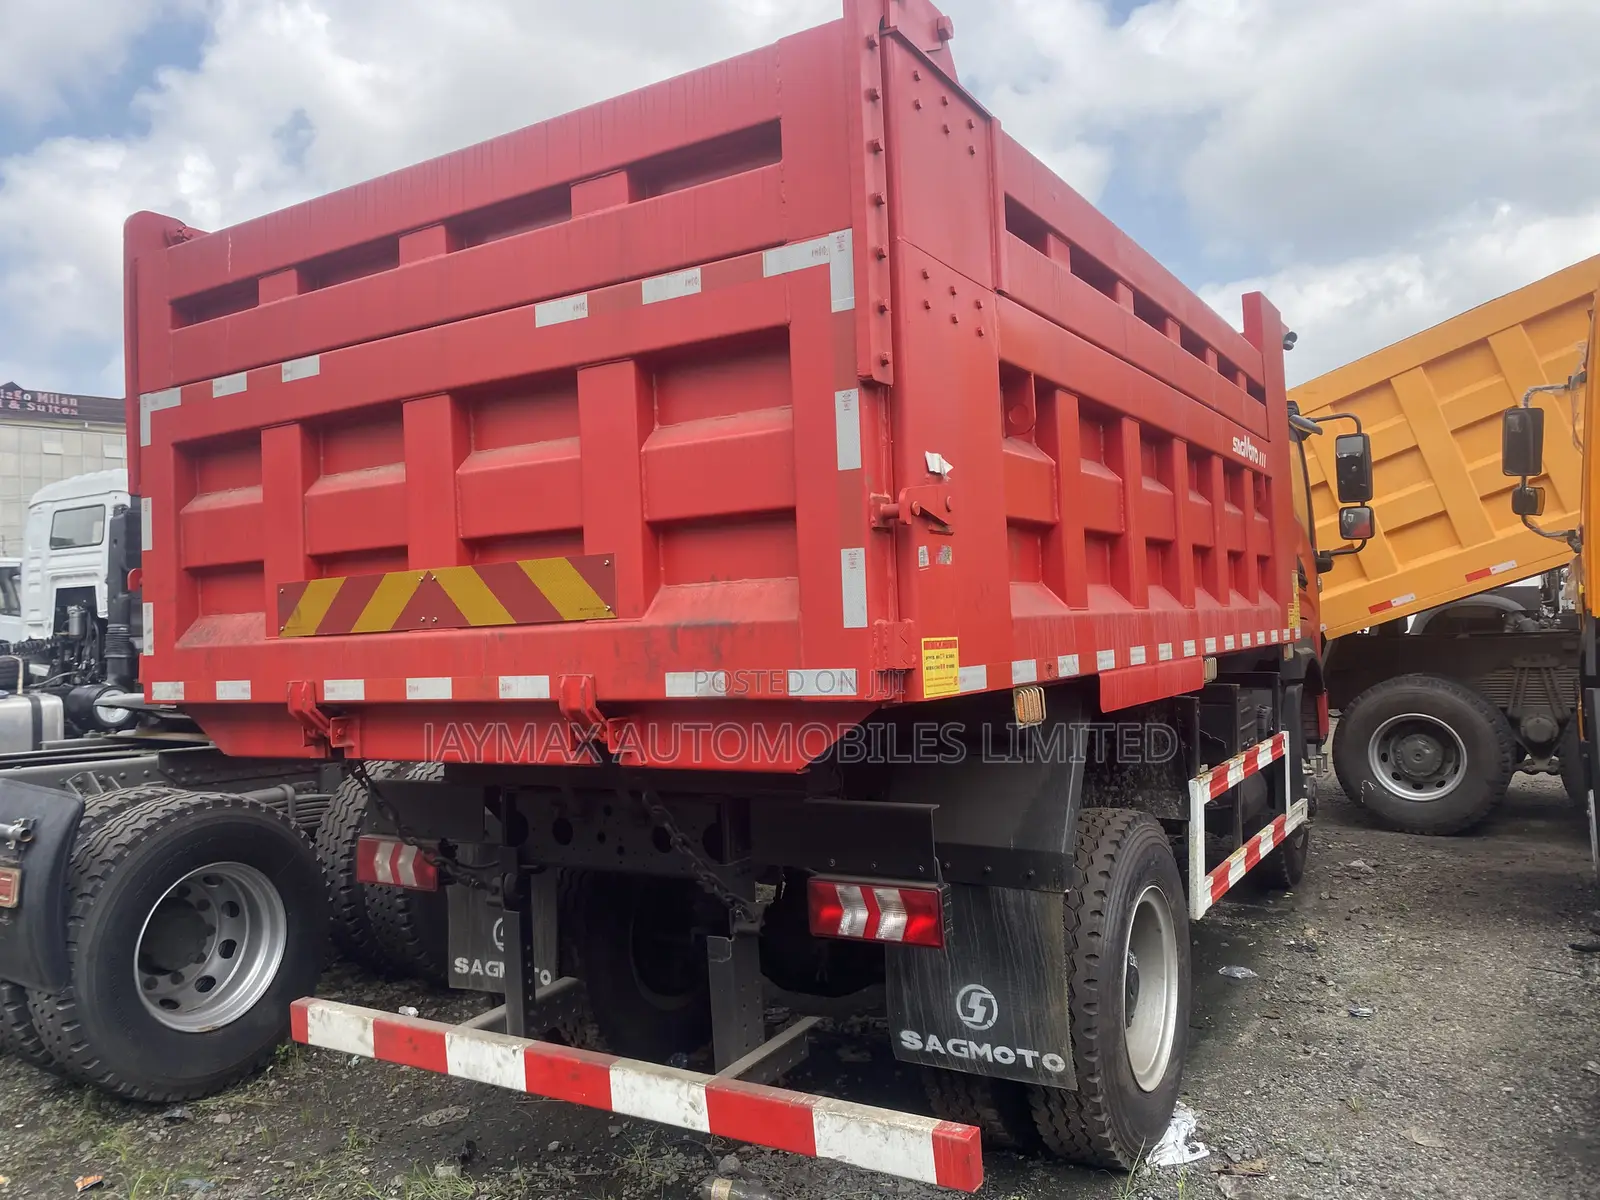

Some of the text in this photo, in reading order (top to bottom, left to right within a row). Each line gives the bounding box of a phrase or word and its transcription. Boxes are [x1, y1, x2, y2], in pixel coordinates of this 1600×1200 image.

[37, 393, 77, 406] Milan
[26, 402, 78, 415] Suites
[900, 1030, 1066, 1072] SAGMOTO
